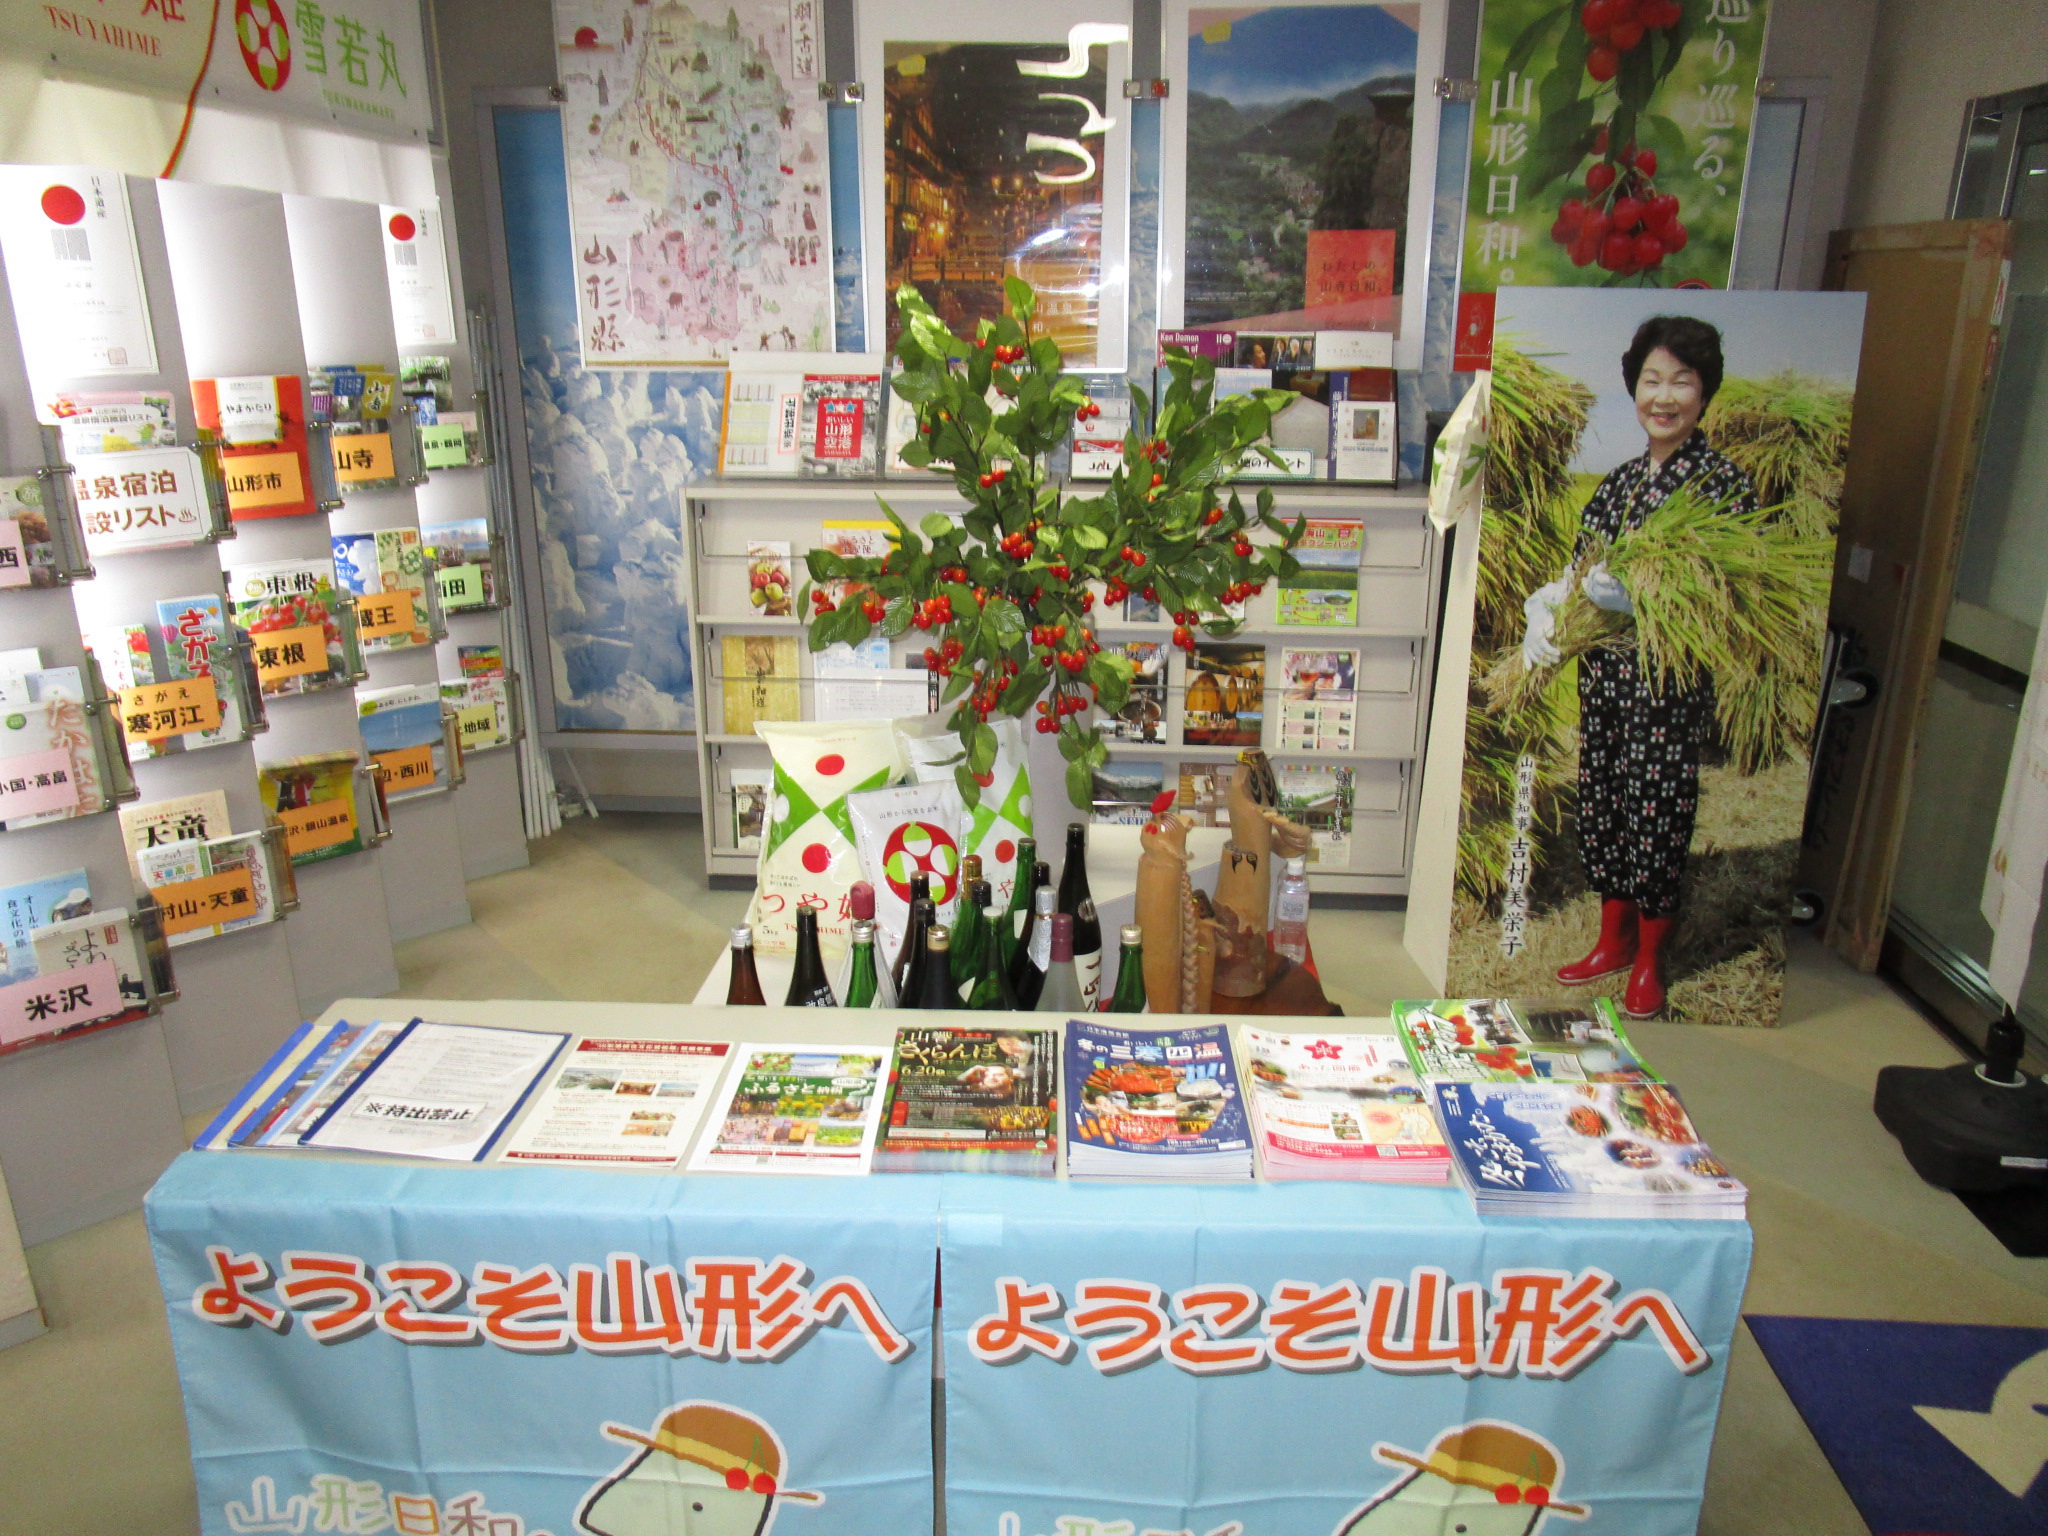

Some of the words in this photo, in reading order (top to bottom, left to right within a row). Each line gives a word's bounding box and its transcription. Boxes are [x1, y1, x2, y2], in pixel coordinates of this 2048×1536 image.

[43, 5, 162, 57] TSUYAHIME
[296, 0, 407, 98] 雪若丸
[1476, 71, 1533, 283] 山形日和。
[1160, 333, 1175, 342] Ken
[823, 436, 852, 449] 空港
[825, 424, 853, 436] 山形
[338, 448, 374, 471] 山寺
[228, 472, 282, 492] 山形市
[265, 571, 317, 596] 東根
[257, 642, 306, 670] 東根
[133, 686, 190, 706] さがえ
[126, 704, 205, 734] 寒河江
[1515, 757, 1533, 830] 山形県知事
[1500, 837, 1530, 957] 吉村美栄子
[24, 982, 93, 1022] 米沢
[362, 1102, 475, 1123] ※持出禁止
[193, 1248, 911, 1363] ようこそ山形へ
[969, 1265, 1710, 1375] ようこそ山形へ
[226, 1474, 554, 1536] 山形日和
